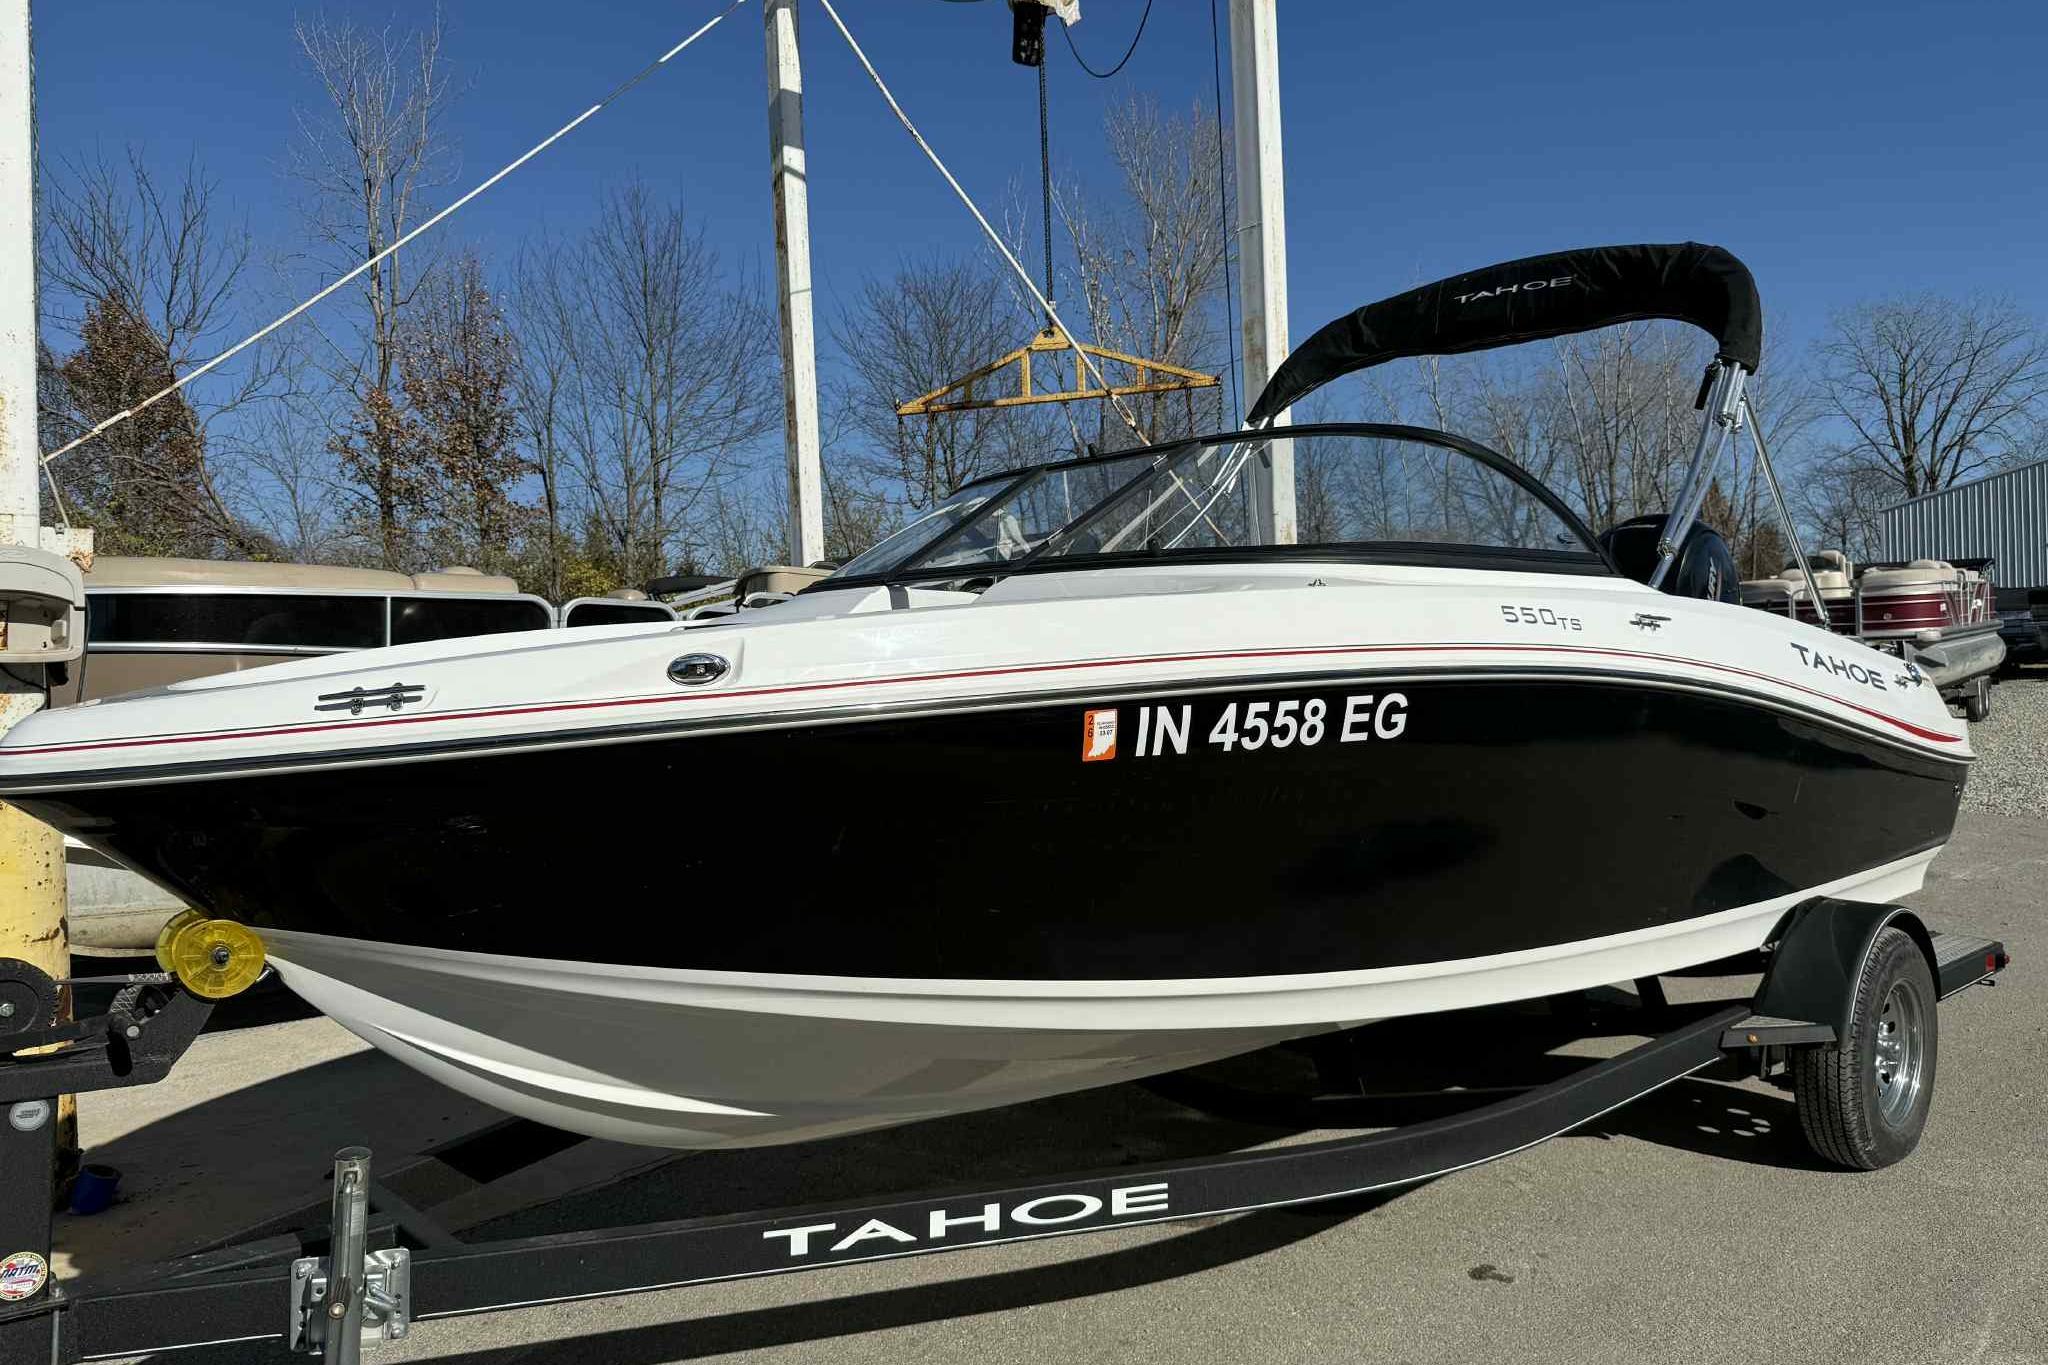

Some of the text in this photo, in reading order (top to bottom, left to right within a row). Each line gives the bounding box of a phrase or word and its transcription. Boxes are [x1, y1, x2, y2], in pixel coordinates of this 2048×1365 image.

[1453, 276, 1573, 304] TAHOE
[1790, 642, 1887, 691] TAHOE
[1135, 692, 1408, 757] IN 4558 EG
[763, 1183, 1169, 1256] TAHOE
